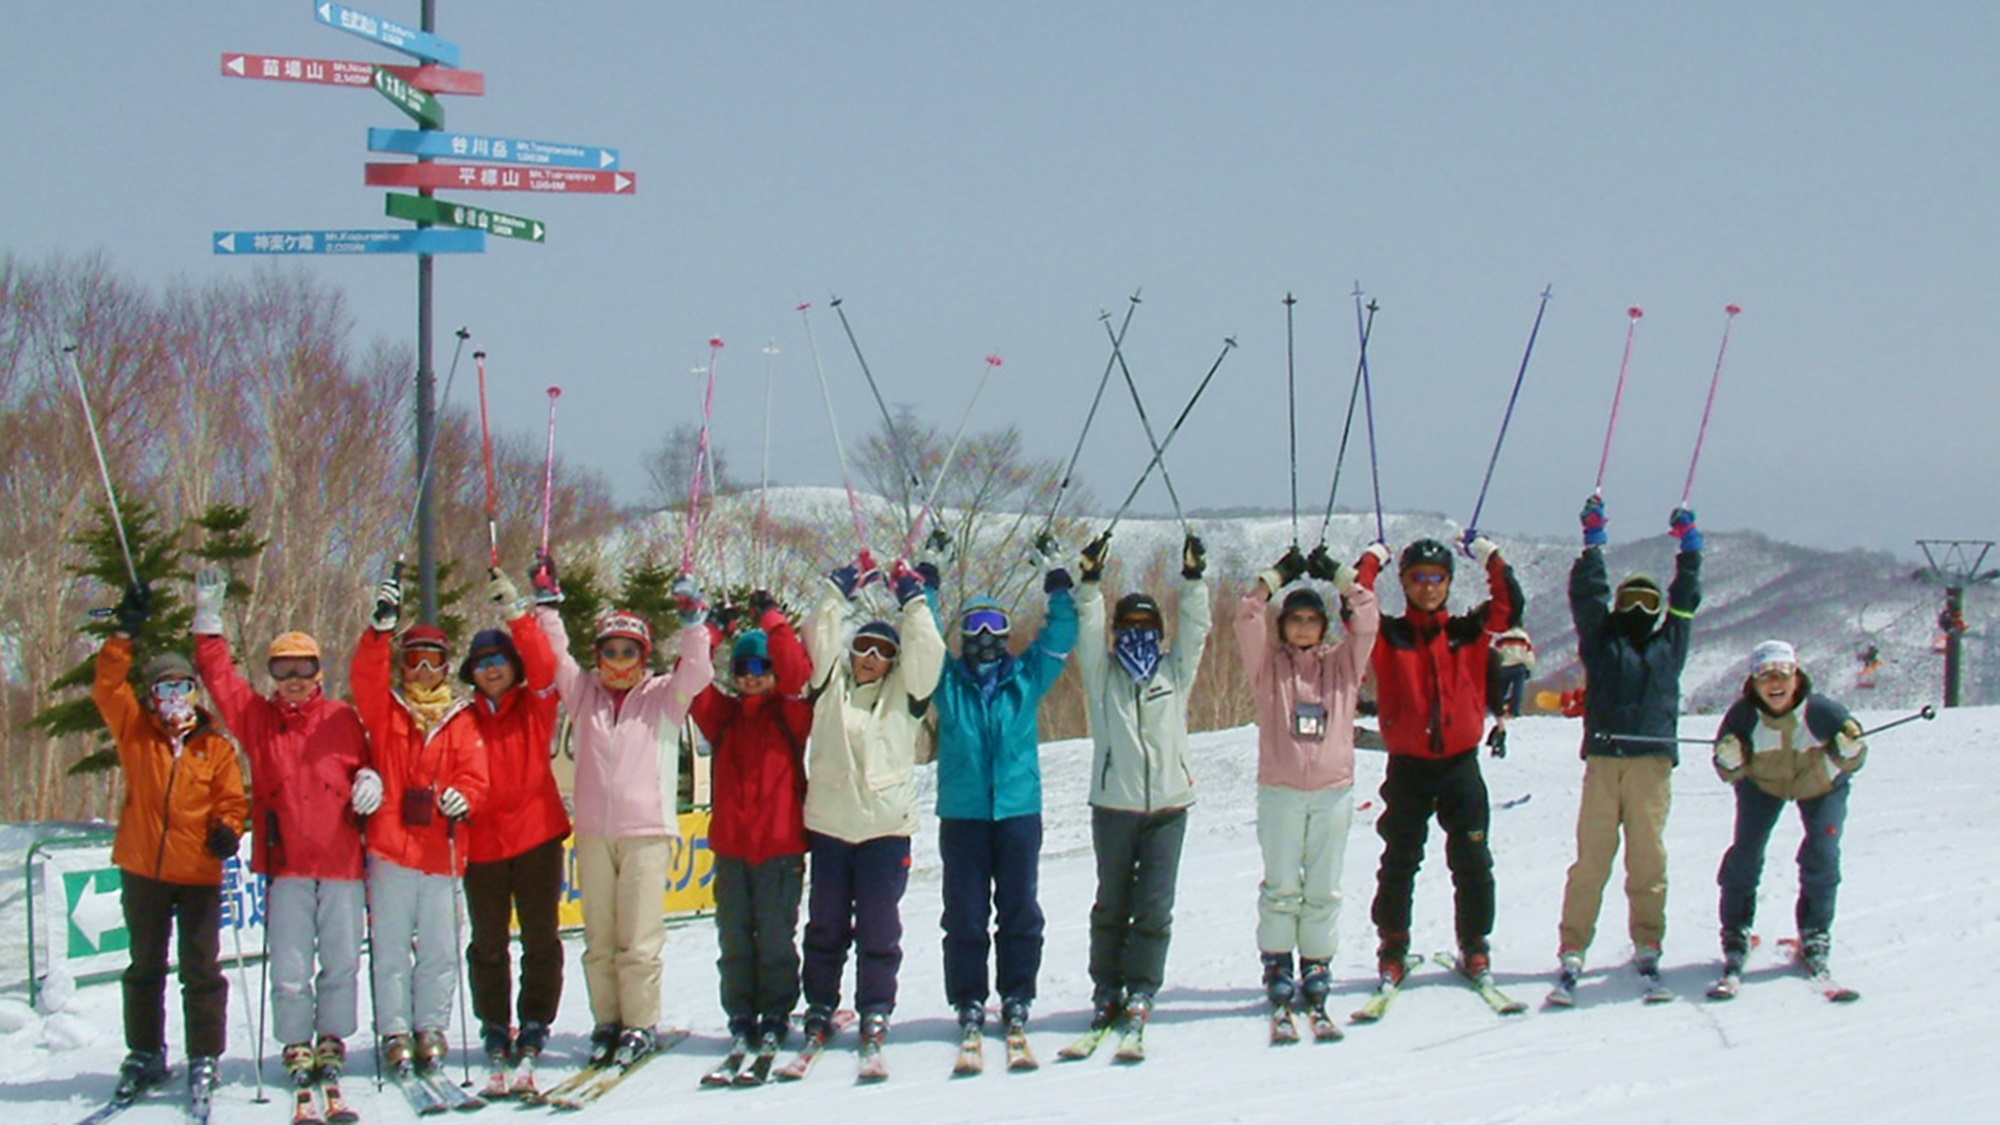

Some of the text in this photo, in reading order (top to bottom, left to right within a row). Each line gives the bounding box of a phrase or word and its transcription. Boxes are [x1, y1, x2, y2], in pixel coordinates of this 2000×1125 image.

[263, 58, 324, 80] 苗場山
[452, 136, 508, 159] 谷川岳
[458, 167, 520, 187] 平標山
